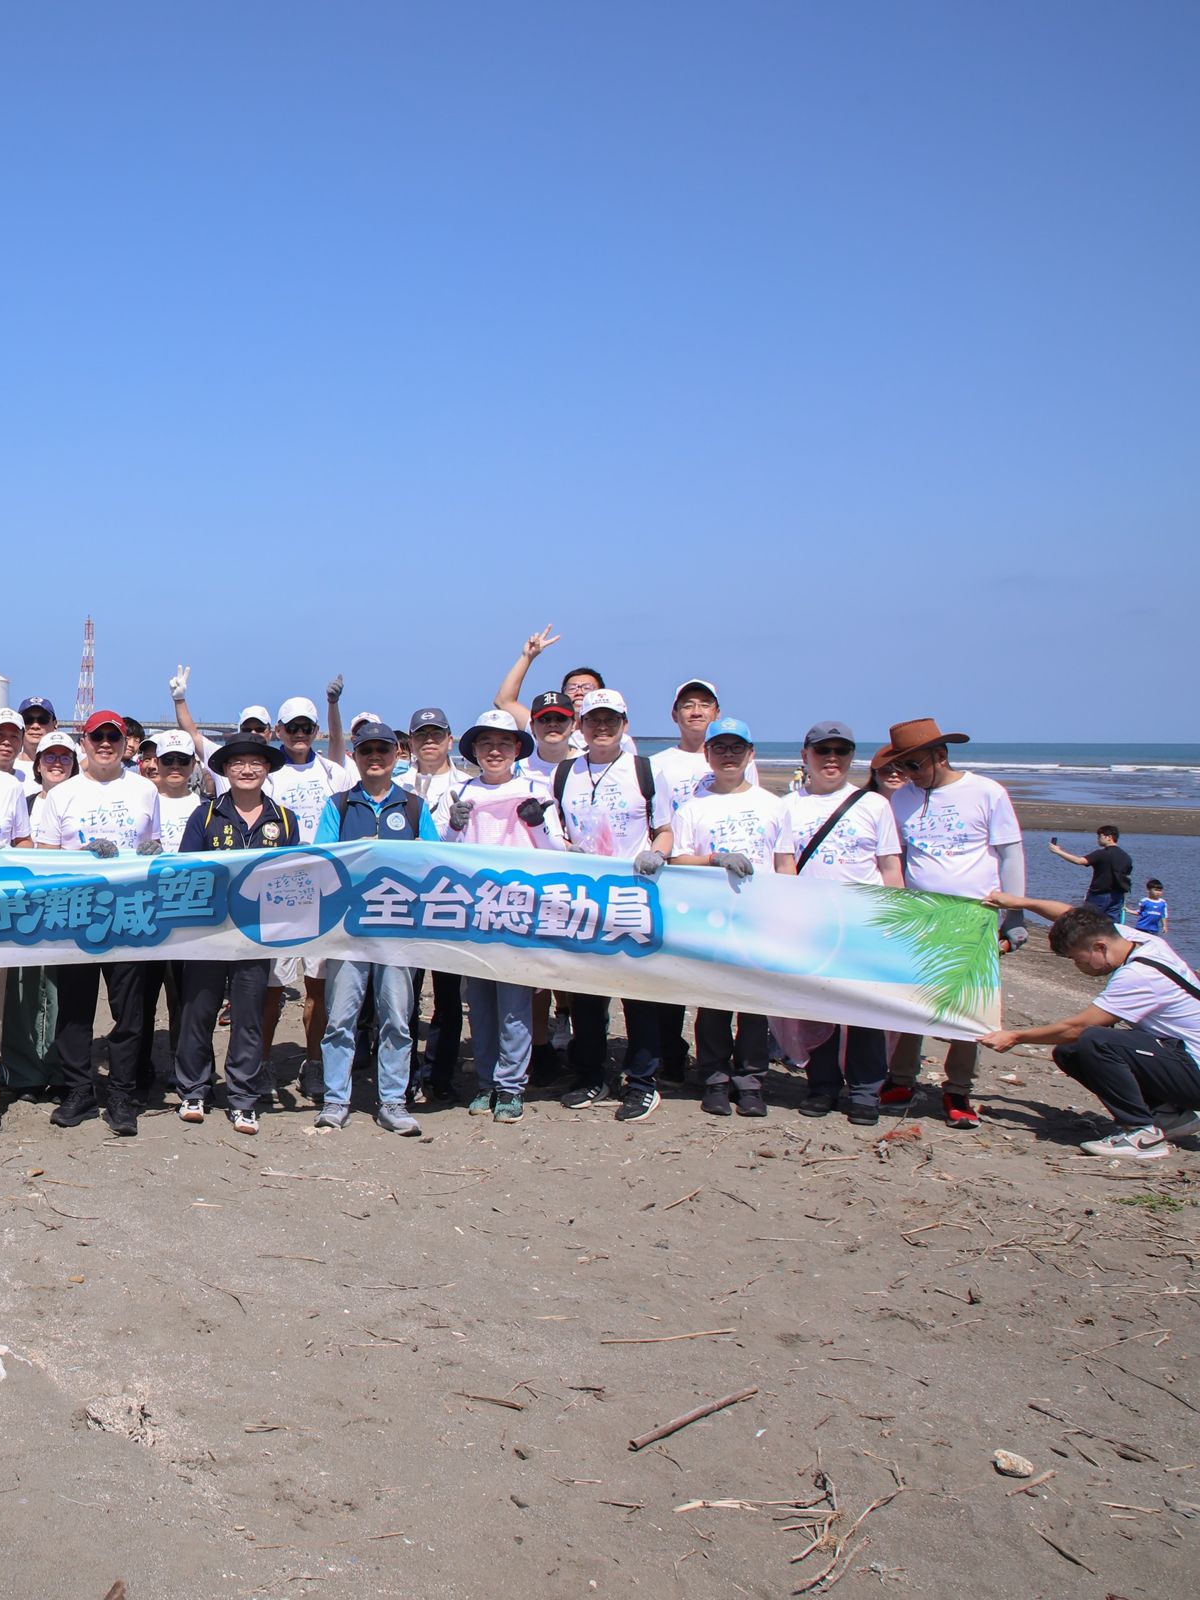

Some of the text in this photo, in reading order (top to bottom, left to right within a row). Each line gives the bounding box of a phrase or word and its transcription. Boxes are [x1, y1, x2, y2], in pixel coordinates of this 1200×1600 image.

[544, 693, 558, 705] H
[224, 824, 234, 850] 副局
[358, 876, 650, 944] 全台總動員
